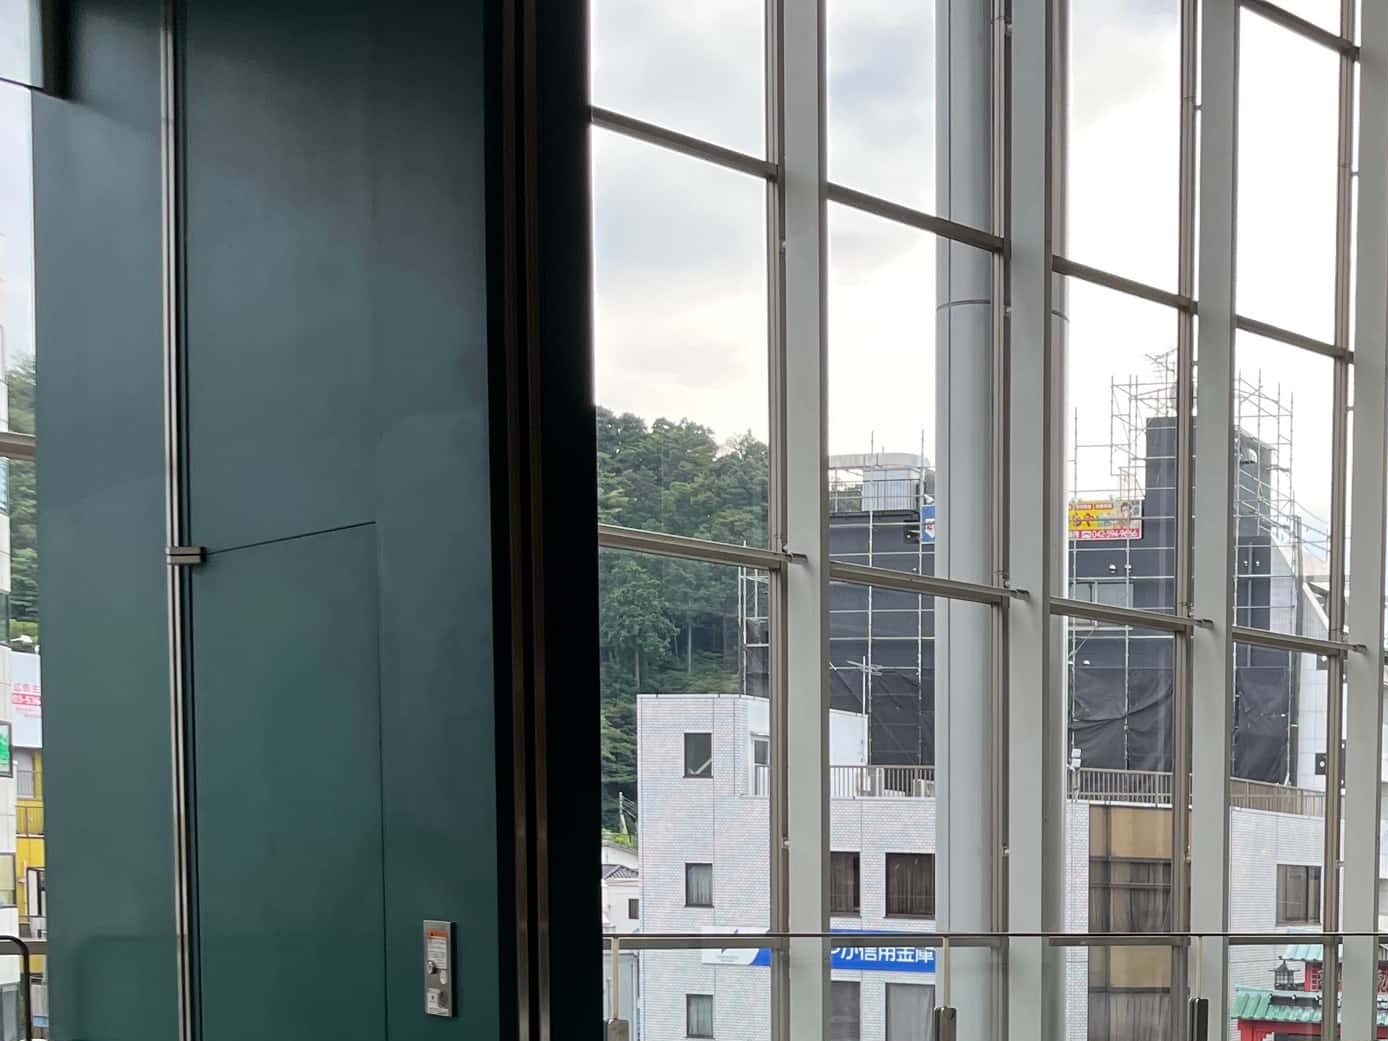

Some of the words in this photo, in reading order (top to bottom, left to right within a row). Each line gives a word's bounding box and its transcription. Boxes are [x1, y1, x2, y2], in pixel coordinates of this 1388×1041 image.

[831, 946, 935, 963] か信用金庫
